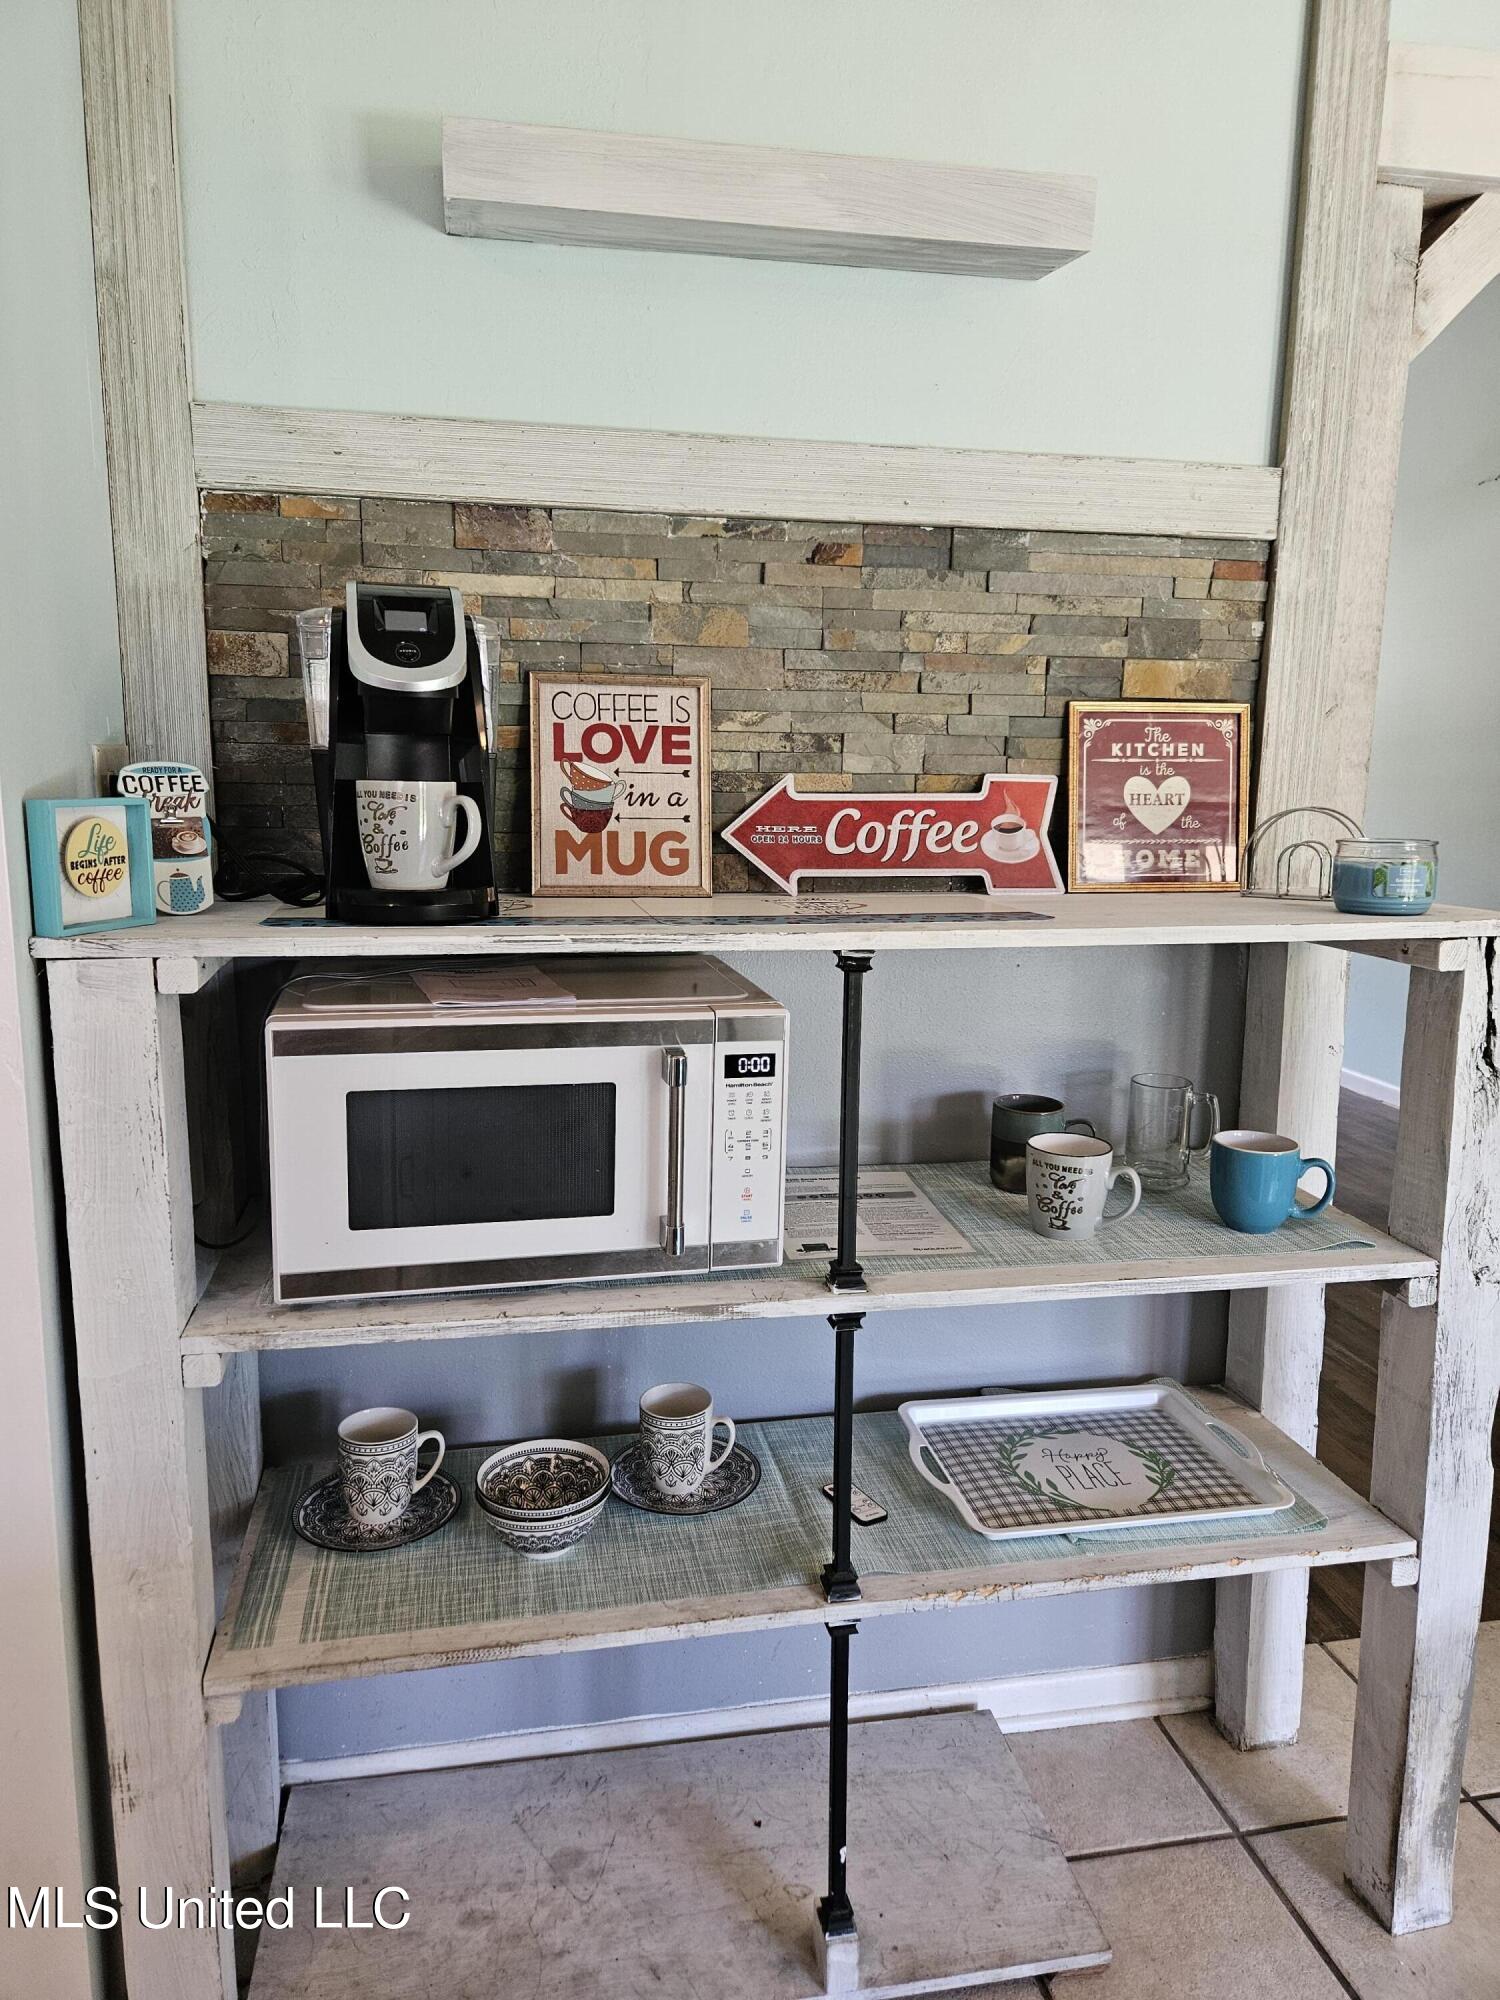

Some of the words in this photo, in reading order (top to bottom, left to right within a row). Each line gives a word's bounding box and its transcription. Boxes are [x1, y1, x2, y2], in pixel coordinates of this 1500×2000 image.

[551, 690, 658, 723] COFFEE
[670, 695, 691, 724] IS
[552, 722, 693, 764] LOVE
[1144, 727, 1172, 743] The
[1111, 742, 1205, 757] KITCHEN
[142, 766, 163, 774] READY
[164, 766, 176, 774] FOR
[1139, 763, 1152, 776] is
[1155, 761, 1175, 776] the
[121, 775, 205, 794] COFFEE
[363, 790, 378, 799] YOU
[405, 793, 417, 803] IS
[624, 783, 660, 807] in
[667, 791, 689, 808] a
[1129, 792, 1186, 806] HEART
[372, 823, 385, 835] &
[1113, 812, 1127, 830] of
[1180, 815, 1201, 829] the
[77, 822, 117, 866] Life
[751, 834, 776, 844] OPEN
[778, 834, 790, 844] 24
[791, 834, 824, 845] HOURS
[755, 825, 818, 833] HERE
[825, 807, 979, 864] Coffee
[361, 833, 409, 858] Coffee
[555, 829, 690, 876] MUG
[70, 858, 98, 871] BEGINS
[103, 855, 126, 867] AFTER
[77, 867, 124, 894] coffee
[738, 1056, 770, 1073] 0:00
[1044, 1162, 1060, 1173] YOU
[1062, 1165, 1084, 1175] NEED
[1051, 1190, 1064, 1200] &
[1036, 1194, 1084, 1220] Coffee
[1041, 1446, 1109, 1463] Happy
[1054, 1460, 1132, 1491] PLACE
